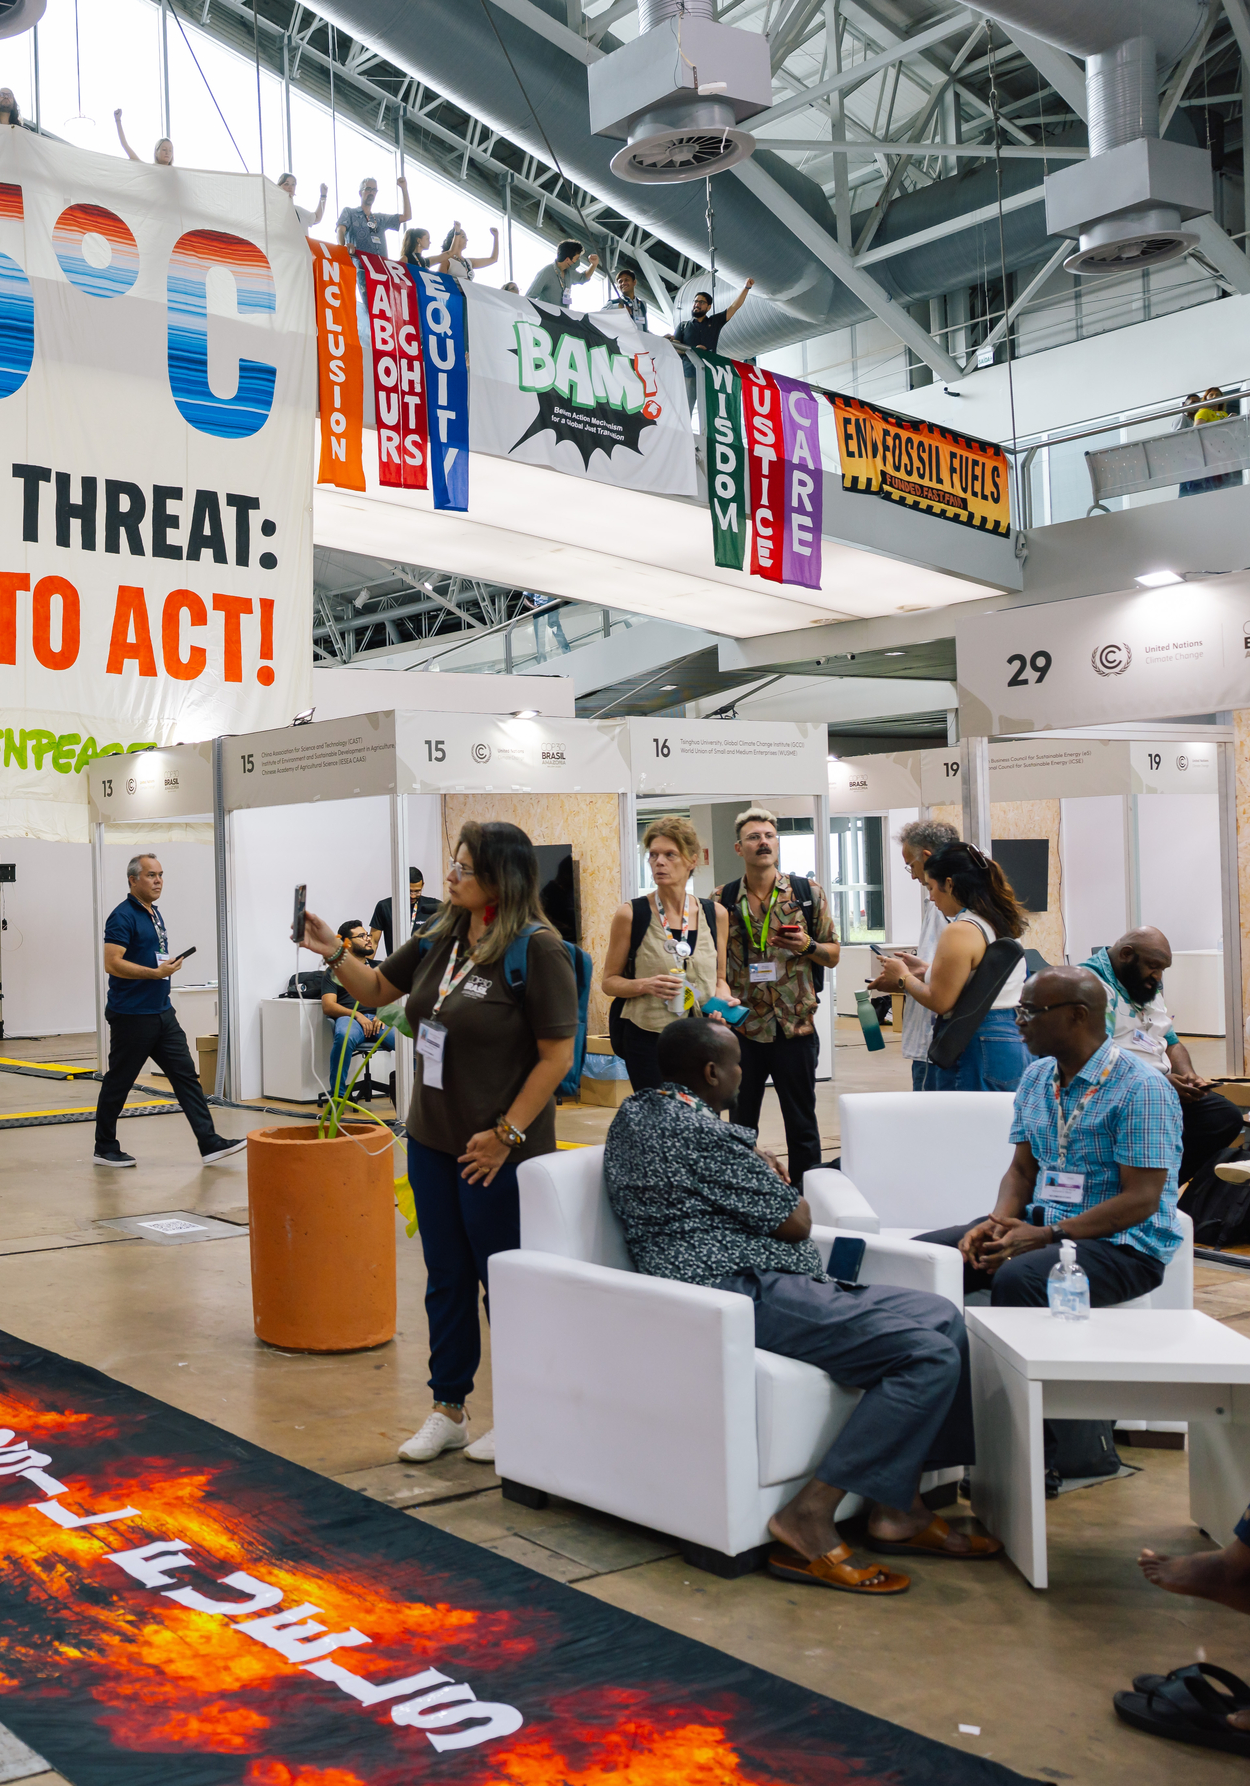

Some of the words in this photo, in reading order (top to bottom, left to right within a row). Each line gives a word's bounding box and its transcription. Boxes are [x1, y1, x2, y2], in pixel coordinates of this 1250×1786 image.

[318, 242, 347, 463] INCLUSION
[361, 254, 401, 465] LABOUR
[384, 260, 423, 466] RIGHTS
[512, 320, 662, 420] BAM!
[551, 414, 560, 422] for
[584, 424, 596, 434] Just
[572, 412, 590, 423] Action
[702, 357, 739, 534] WISDOM
[748, 365, 776, 569] JUSTICE
[788, 391, 815, 557] CARE
[882, 427, 944, 486] FOSSIL
[949, 450, 1001, 504] FUELS
[12, 462, 279, 570] THREAT:
[105, 584, 276, 687] ACT!
[1144, 644, 1170, 654] United
[1172, 640, 1203, 650] Nations
[1146, 655, 1173, 665] Climate
[1175, 650, 1204, 660] Change
[1007, 650, 1052, 688] 29
[324, 740, 348, 750] Technology
[348, 737, 363, 746] (CAST)
[424, 740, 446, 762] 15
[653, 738, 671, 758] 16
[240, 754, 255, 774] 15
[277, 766, 294, 774] Academy
[300, 762, 322, 771] Agricultural
[353, 756, 366, 764] CAAS)
[282, 755, 306, 764] Environment
[314, 751, 337, 760] Sustainable
[338, 747, 365, 756] Development
[1148, 753, 1161, 771] 19
[943, 762, 960, 777] 19
[102, 779, 113, 798] 13
[164, 778, 179, 786] BRASIL
[102, 1537, 524, 1753] FUELS
